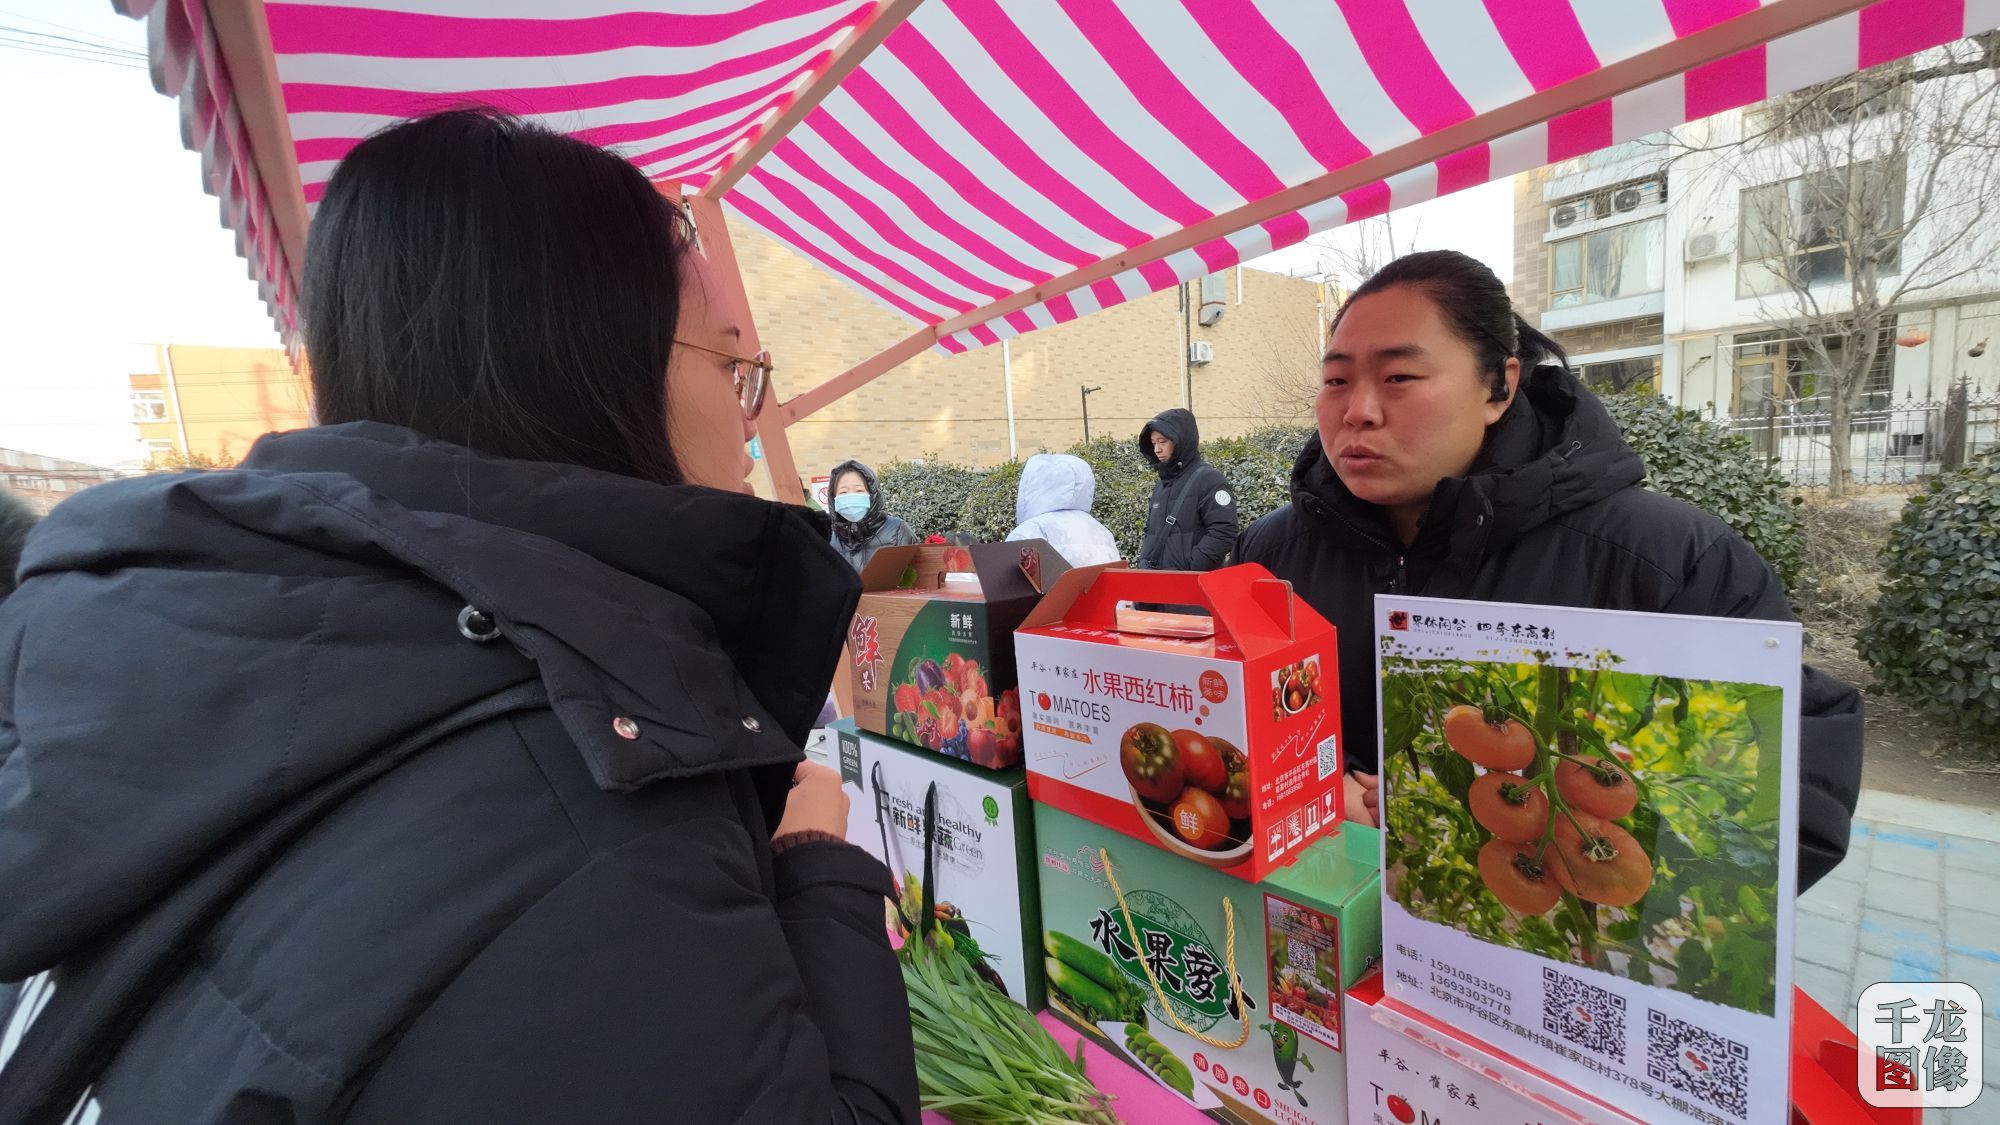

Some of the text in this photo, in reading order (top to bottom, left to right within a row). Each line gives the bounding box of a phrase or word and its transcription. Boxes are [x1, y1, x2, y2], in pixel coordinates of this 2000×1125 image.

[950, 613, 973, 630] 新鲜
[1082, 668, 1194, 714] 水果西红柿
[892, 807, 953, 851] 新鲜蔬
[938, 813, 982, 842] healthy
[1179, 809, 1199, 834] 鲜
[953, 836, 983, 859] Green
[1430, 958, 1512, 1001] 15910833503
[1430, 972, 1511, 1015] 13693303778
[1430, 986, 1735, 1125] 北京市平谷区东高村镇崔家庄村378号大棚浩萍
